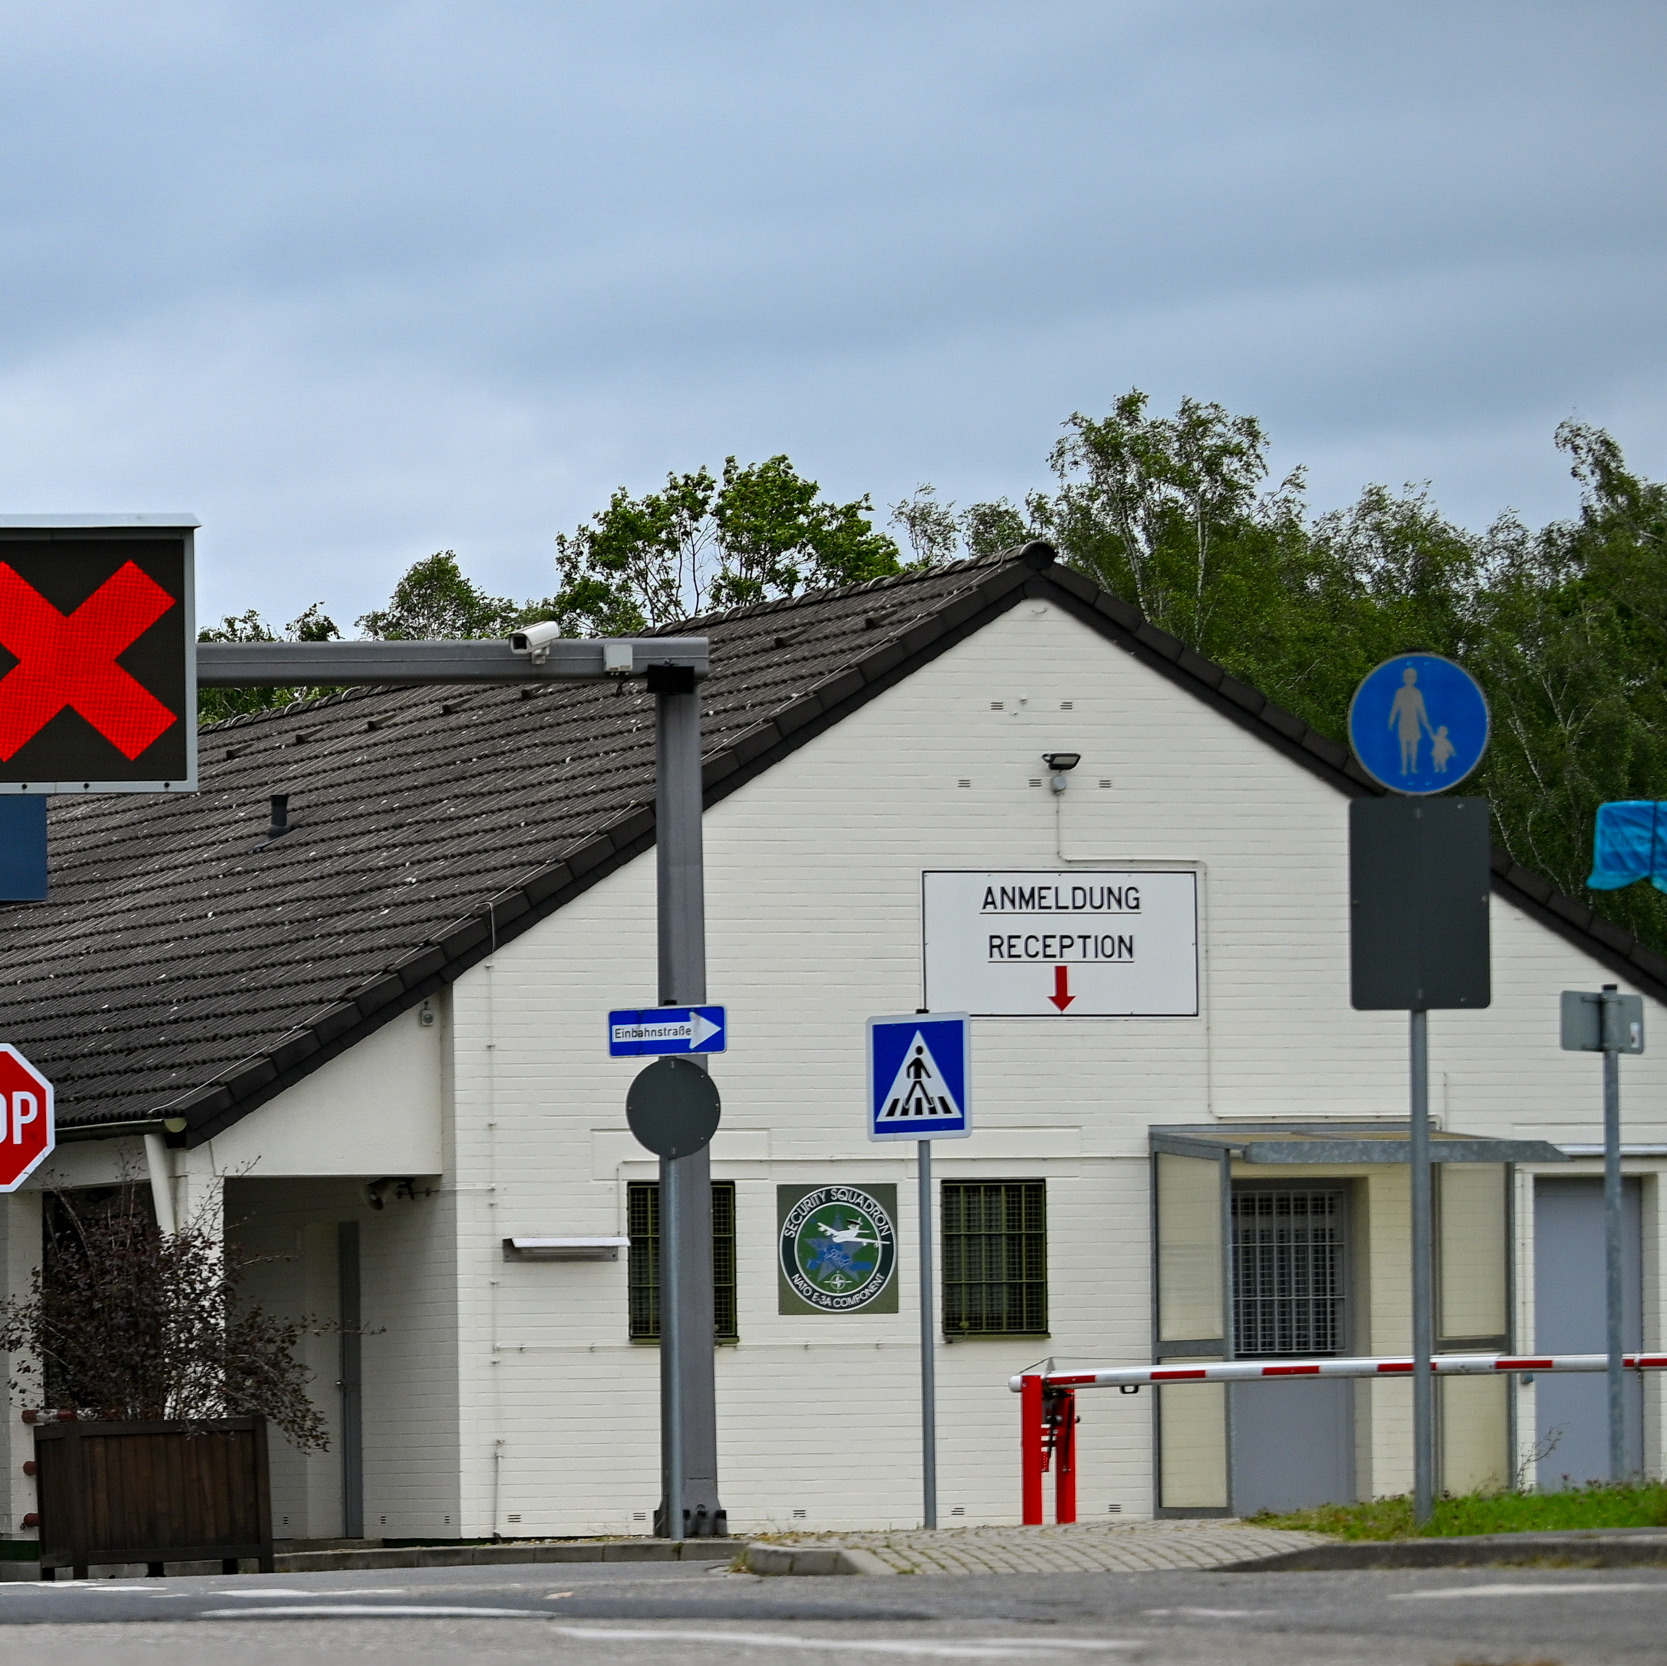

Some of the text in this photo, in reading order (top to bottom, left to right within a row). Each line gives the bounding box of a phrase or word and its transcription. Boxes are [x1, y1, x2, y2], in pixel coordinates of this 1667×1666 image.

[981, 886, 1141, 911] ANMELDUNG
[988, 935, 1134, 959] RECEPTION
[614, 1025, 692, 1039] Einbahnstraße
[785, 1188, 891, 1238] SECURITY SQUADRON
[791, 1272, 886, 1308] NATO E-3A COMPONENT
